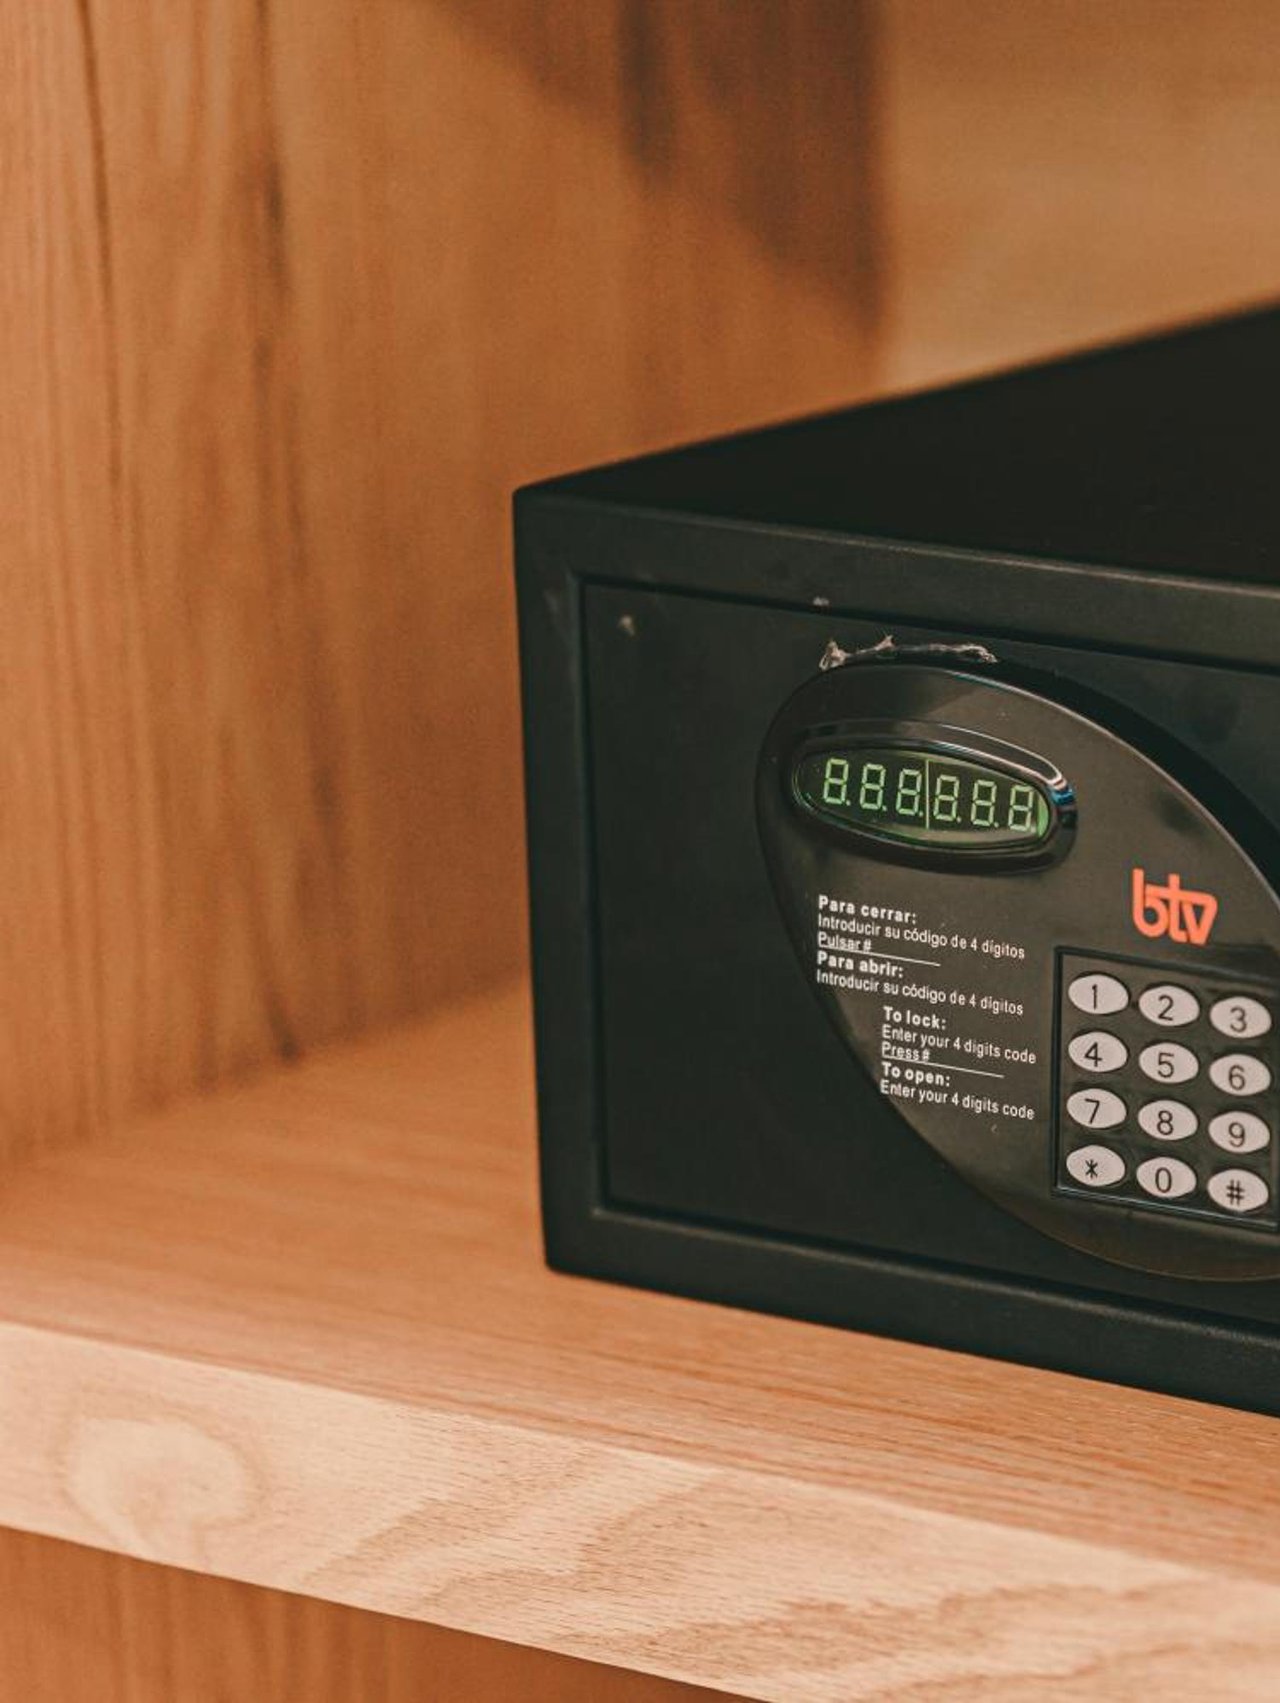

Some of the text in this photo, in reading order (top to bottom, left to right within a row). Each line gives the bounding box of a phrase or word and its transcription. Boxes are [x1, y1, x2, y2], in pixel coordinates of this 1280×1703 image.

[818, 894, 916, 924] Para cerrar:
[1133, 868, 1218, 946] btv
[817, 931, 872, 953] Pulsar #
[818, 914, 880, 936] Introducir
[885, 926, 900, 939] su
[904, 928, 947, 948] código
[951, 934, 967, 950] de
[970, 937, 977, 951] 4
[817, 950, 904, 978] Para abrir:
[816, 969, 879, 992] Introducir
[883, 981, 899, 995] su
[902, 983, 946, 1005] código
[950, 990, 965, 1006] de
[969, 993, 976, 1008] 4
[1091, 984, 1247, 1032] 1 2 3
[883, 1005, 946, 1030] To lock:
[882, 1024, 1037, 1064] Enter your 4 digits code
[882, 1041, 930, 1062] Press #
[882, 1061, 951, 1087] To open:
[1084, 1042, 1246, 1090] 4 5 6
[880, 1079, 1036, 1120] Enter your 4 digits code
[1085, 1099, 1246, 1148] 7 8 9
[1155, 1167, 1172, 1193] 0
[1225, 1179, 1245, 1206] #
